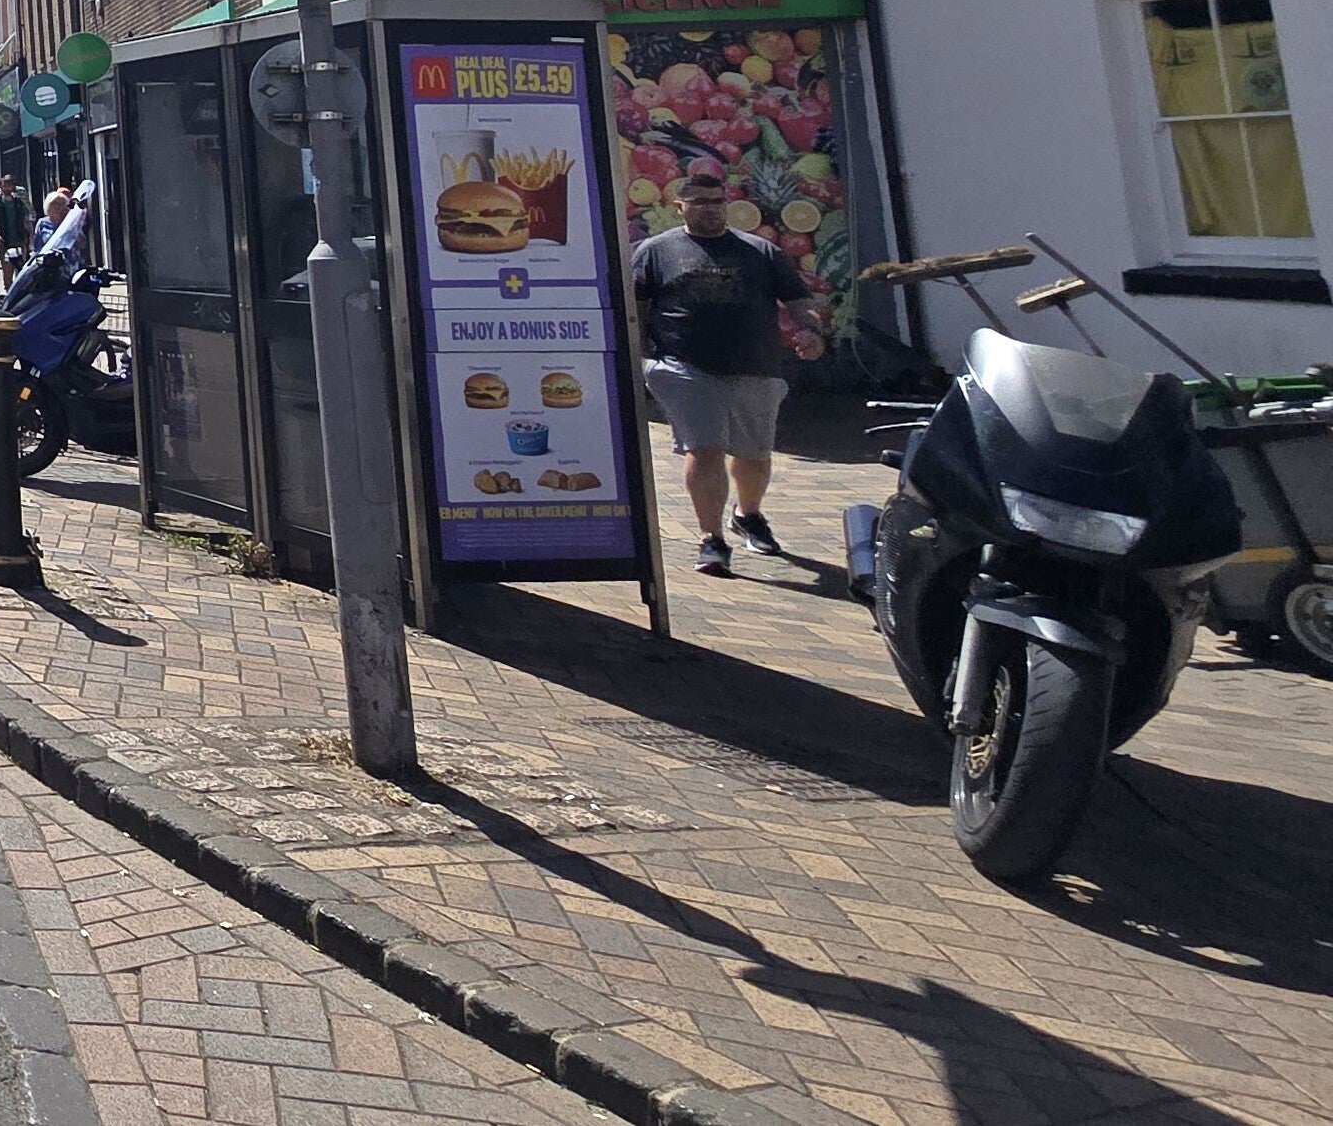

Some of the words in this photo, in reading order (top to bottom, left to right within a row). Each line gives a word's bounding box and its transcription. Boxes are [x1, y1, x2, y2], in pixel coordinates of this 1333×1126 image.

[454, 56, 480, 69] MEAL
[482, 56, 506, 69] DEAL
[455, 69, 509, 100] PLUS
[515, 62, 573, 94] £5.59
[451, 321, 496, 341] ENJOY
[498, 322, 508, 340] A
[510, 320, 557, 340] BONUS
[559, 320, 591, 340] SIDE
